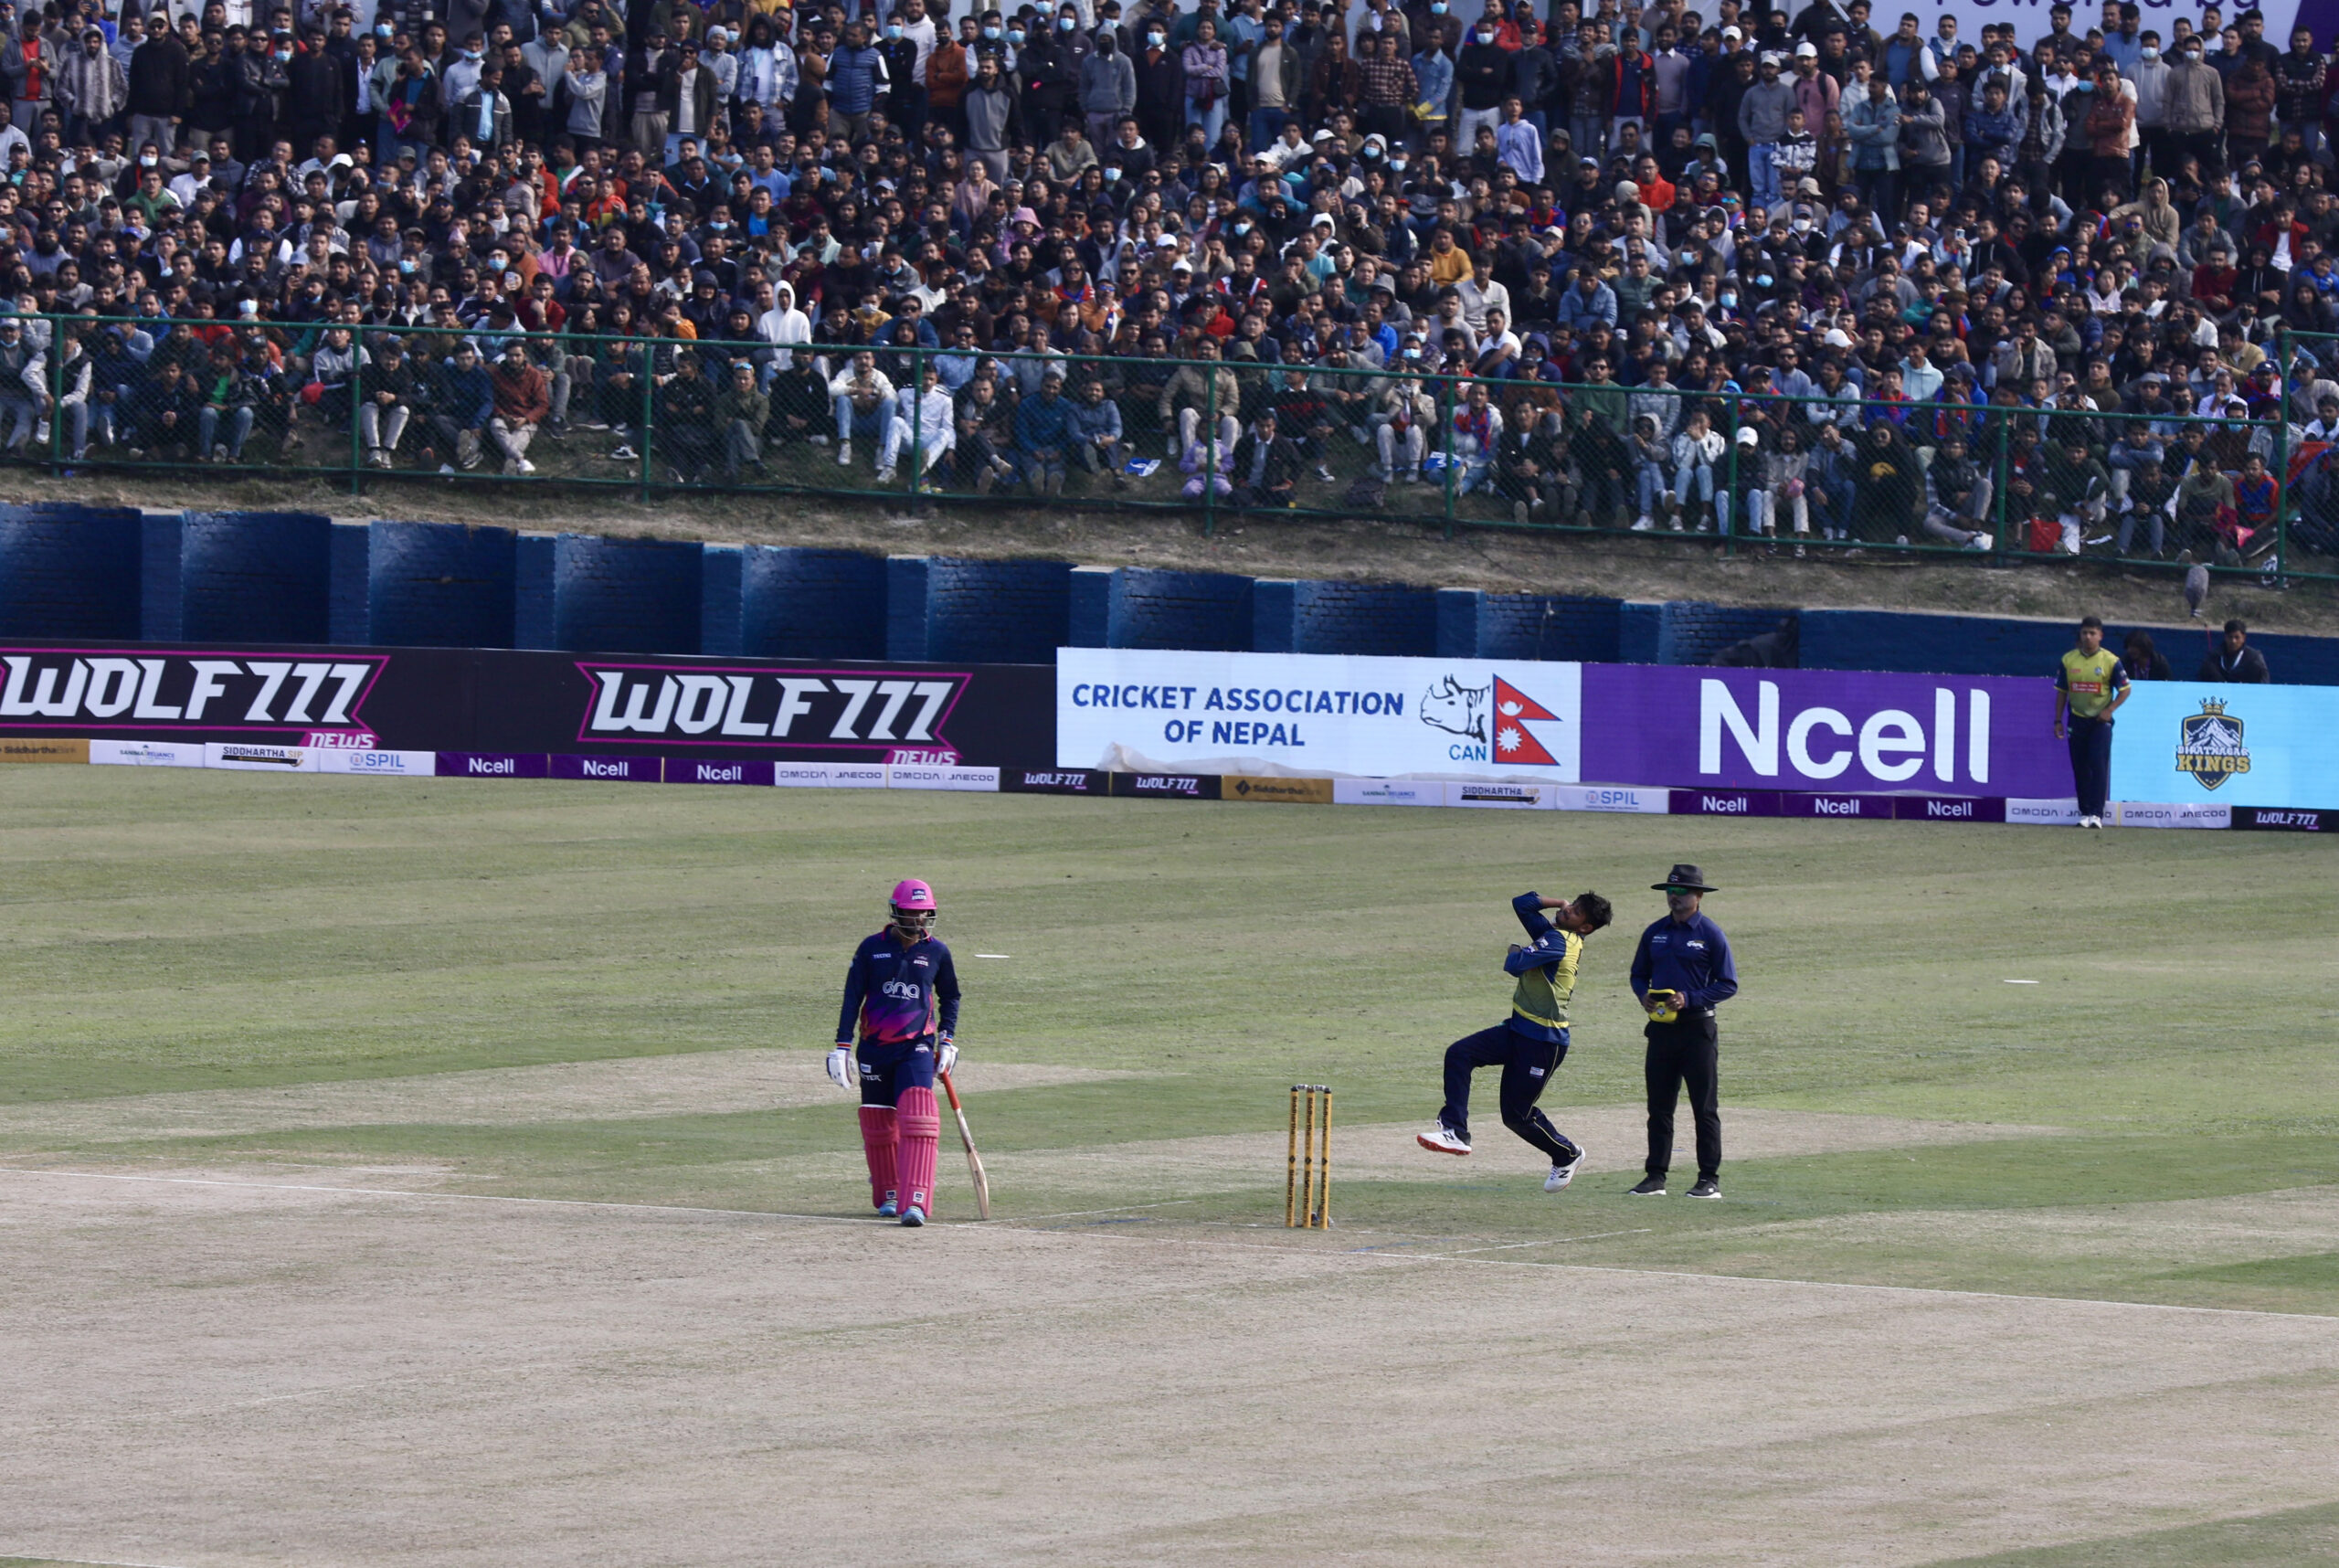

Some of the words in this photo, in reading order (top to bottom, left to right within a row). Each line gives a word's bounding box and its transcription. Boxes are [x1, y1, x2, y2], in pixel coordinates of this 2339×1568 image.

[1072, 683, 1197, 712] CRICKET
[1204, 686, 1404, 716] ASSOCIATION
[1164, 719, 1201, 742] OF
[1212, 720, 1306, 747] NEPAL
[1699, 678, 1991, 784] Ncell
[222, 746, 285, 758] SIDDHARTHA
[287, 749, 304, 759] SIP
[365, 753, 406, 768] SPIL
[1448, 744, 1487, 762] CAN
[468, 757, 514, 774] Ncell
[583, 759, 630, 777] Ncell
[696, 764, 742, 781] Ncell
[2176, 754, 2251, 774] KINGS
[780, 770, 828, 779] OMODA
[893, 771, 941, 781] OMODA
[1462, 785, 1522, 796] SIDDHARTHA
[1524, 788, 1540, 797] SIP
[1601, 790, 1639, 806] SPIL
[1702, 795, 1747, 812] Ncell
[1815, 798, 1860, 814] Ncell
[1927, 800, 1973, 817] Ncell
[2011, 807, 2059, 817] OMODA
[2124, 810, 2173, 819] OMODA
